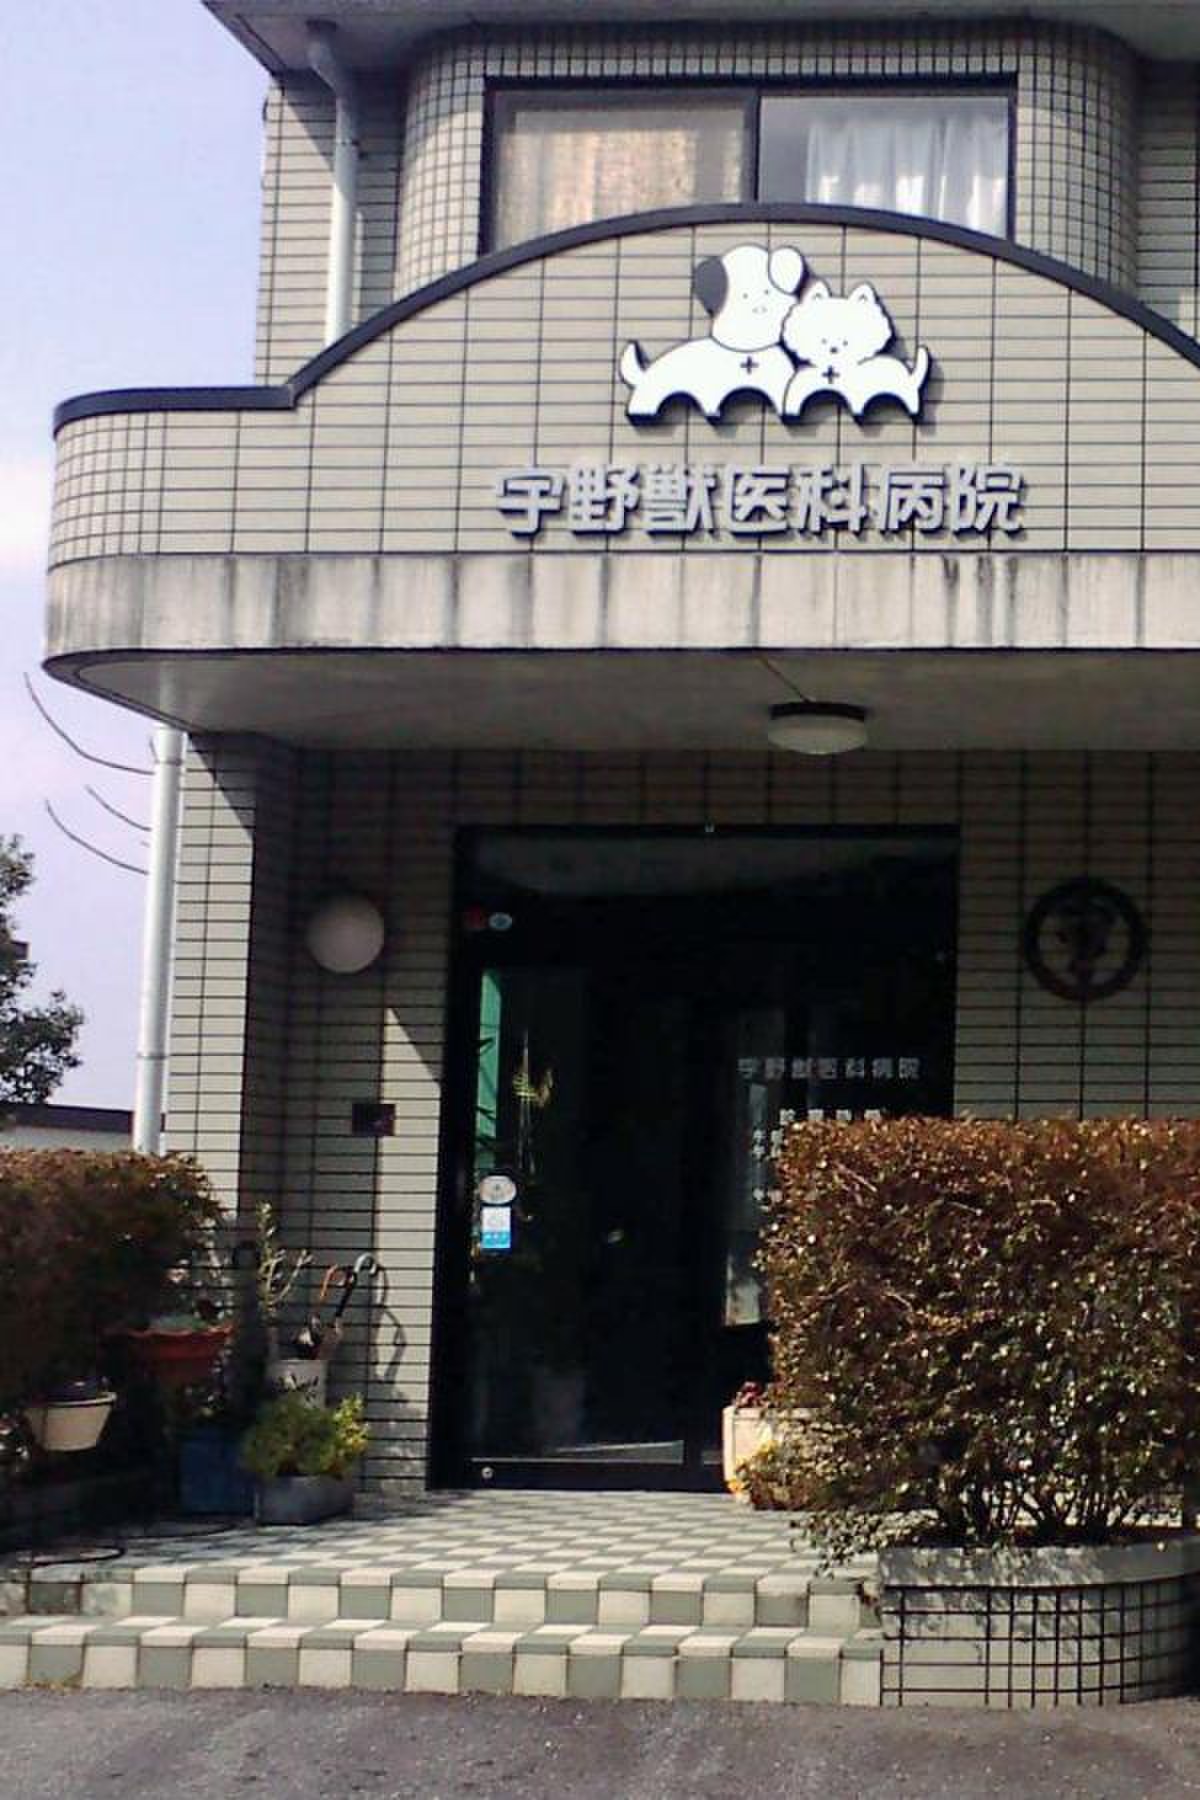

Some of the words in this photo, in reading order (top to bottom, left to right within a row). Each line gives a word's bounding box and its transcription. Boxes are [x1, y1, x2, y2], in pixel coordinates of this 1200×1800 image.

[498, 462, 1025, 533] 宇野獣医科病院
